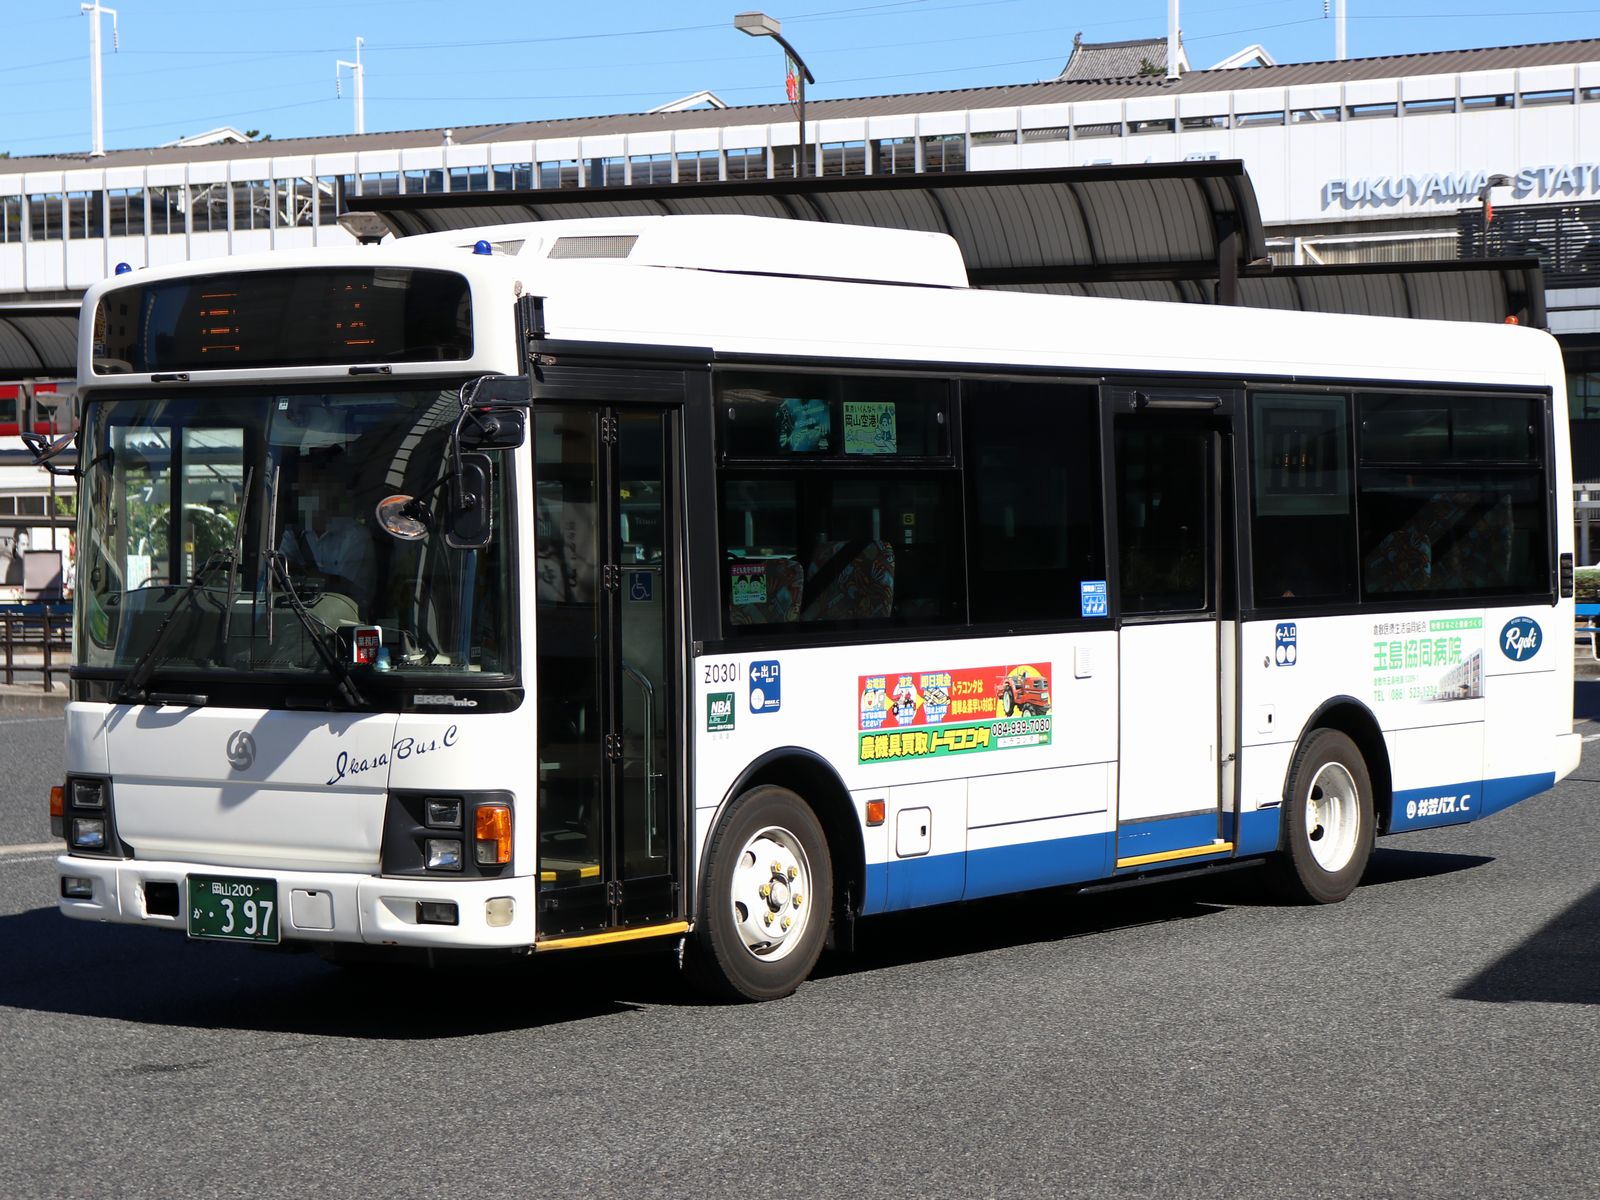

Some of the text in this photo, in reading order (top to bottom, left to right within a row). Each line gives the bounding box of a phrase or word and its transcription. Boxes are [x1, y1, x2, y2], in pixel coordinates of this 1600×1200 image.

[1324, 170, 1489, 203] FUKUYAMA
[143, 486, 153, 502] 7
[1283, 626, 1296, 637] 入口
[1373, 636, 1462, 671] 玉島協同病院
[760, 664, 779, 679] 出口
[952, 679, 984, 696] トラコンタは
[711, 699, 732, 715] NBA
[992, 718, 1050, 736] 084-939-7080
[861, 732, 929, 760] 農機具買取
[326, 751, 389, 785] Ikasa
